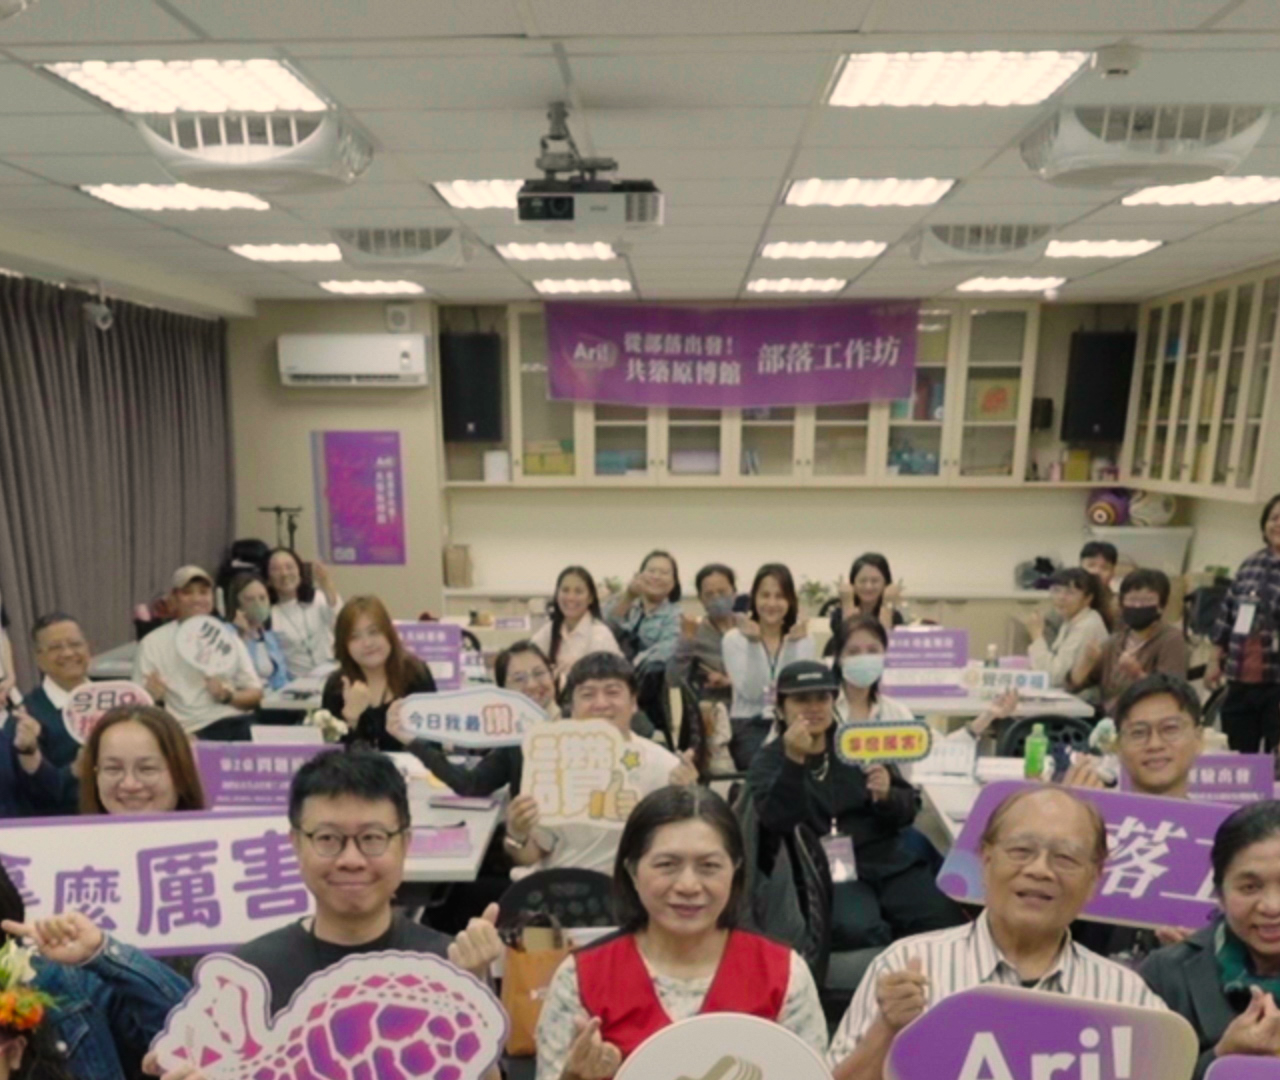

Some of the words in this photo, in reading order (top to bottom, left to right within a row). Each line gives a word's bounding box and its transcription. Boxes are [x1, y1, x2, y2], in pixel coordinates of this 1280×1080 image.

[573, 342, 609, 362] Ari!
[757, 336, 901, 375] 部落工作坊
[625, 359, 741, 386] 共築原博館
